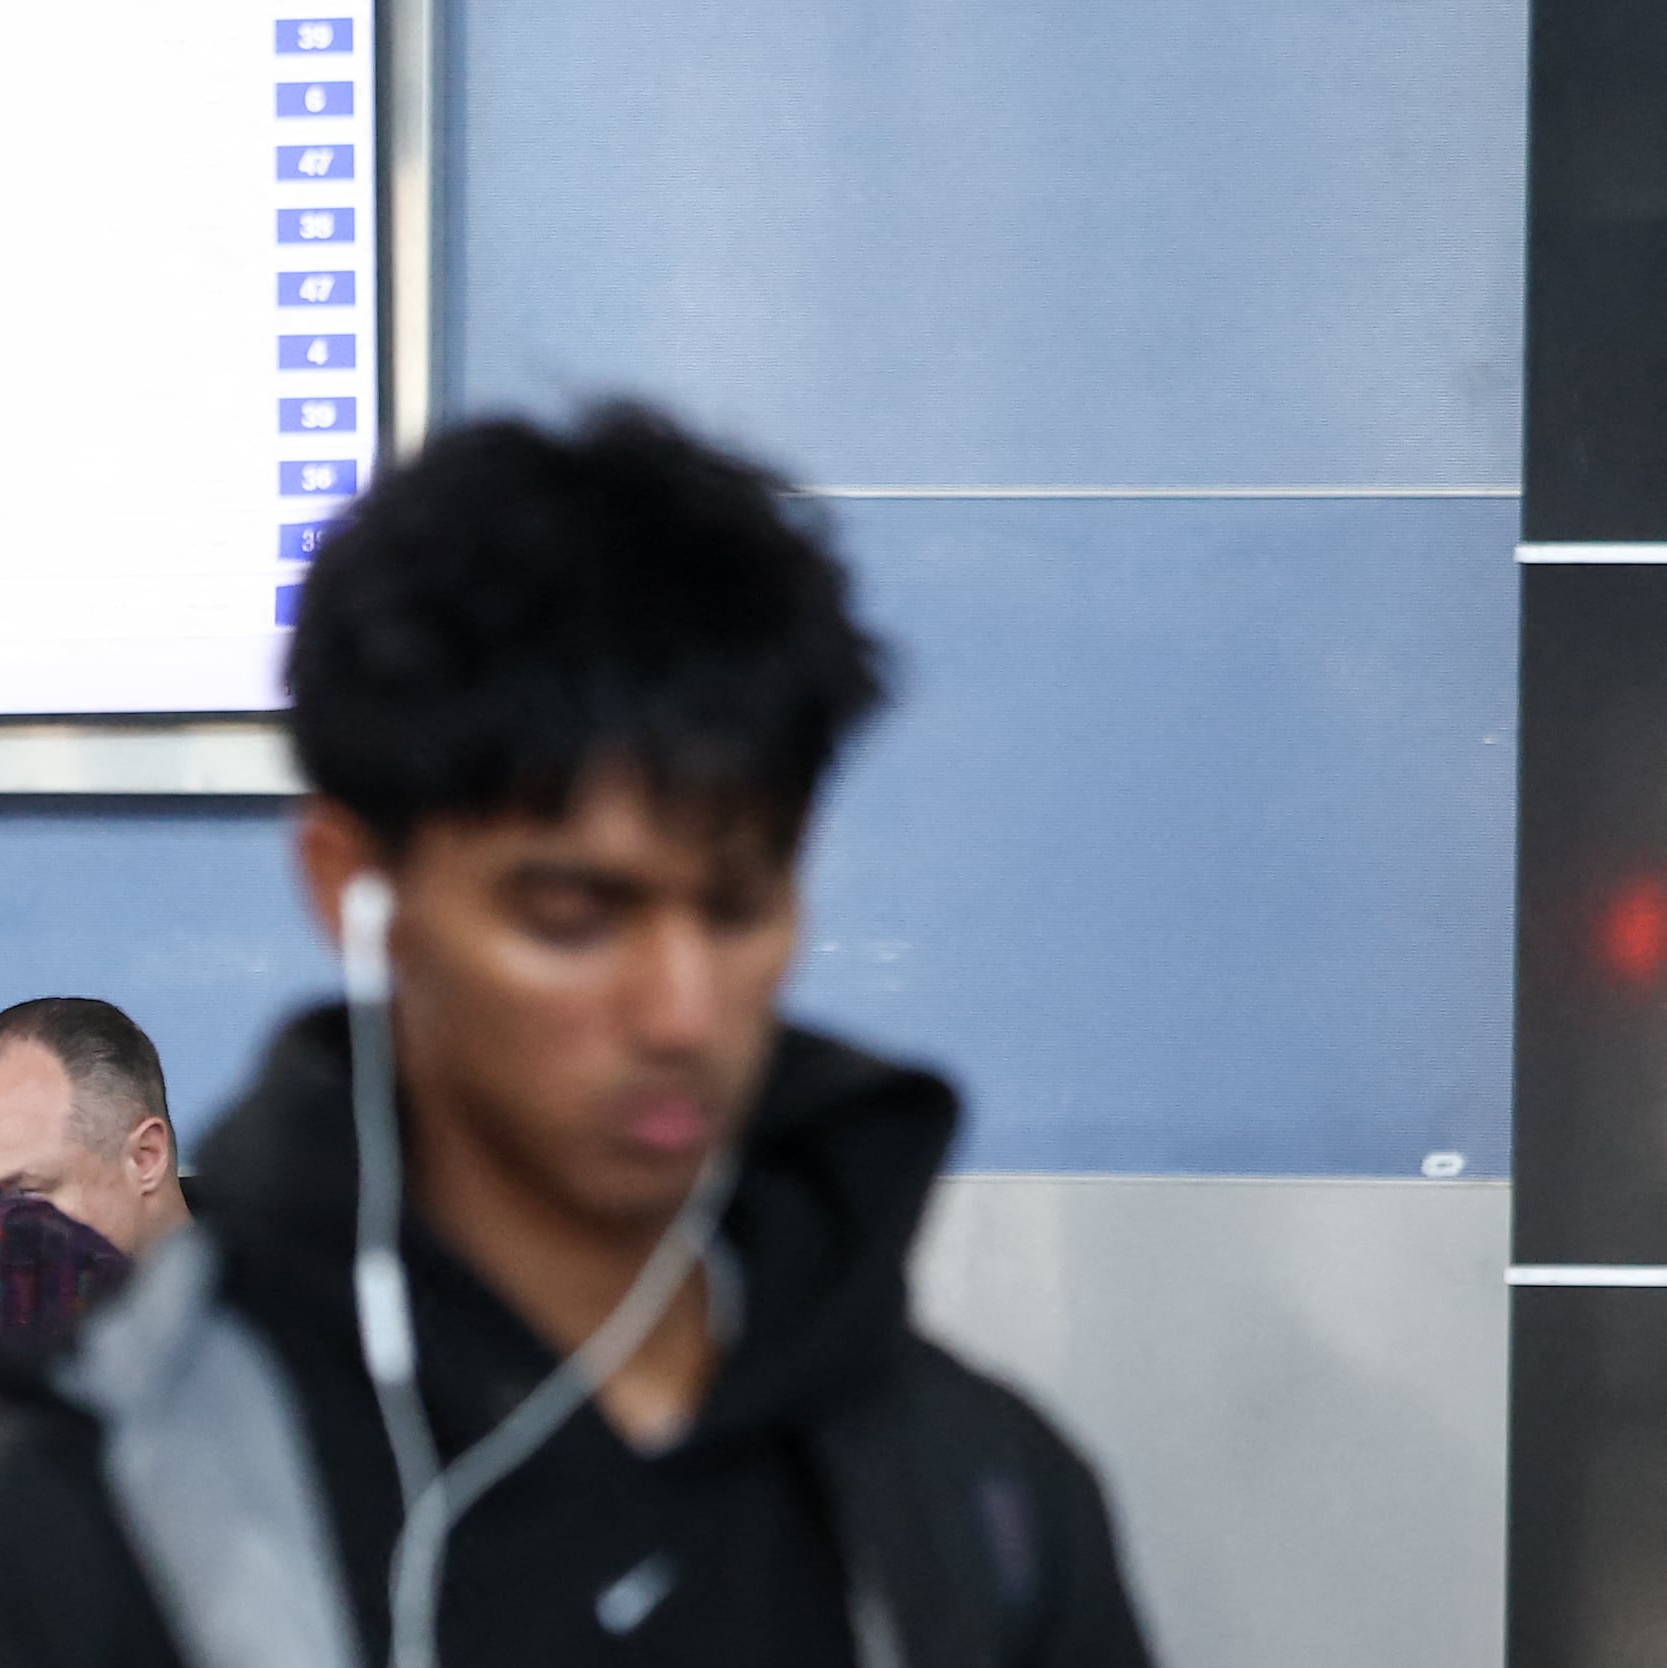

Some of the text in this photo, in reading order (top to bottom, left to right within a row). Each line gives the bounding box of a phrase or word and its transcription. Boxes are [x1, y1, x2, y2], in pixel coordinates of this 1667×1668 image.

[298, 147, 334, 176] 47
[299, 273, 335, 302] 47
[306, 337, 328, 365] 4
